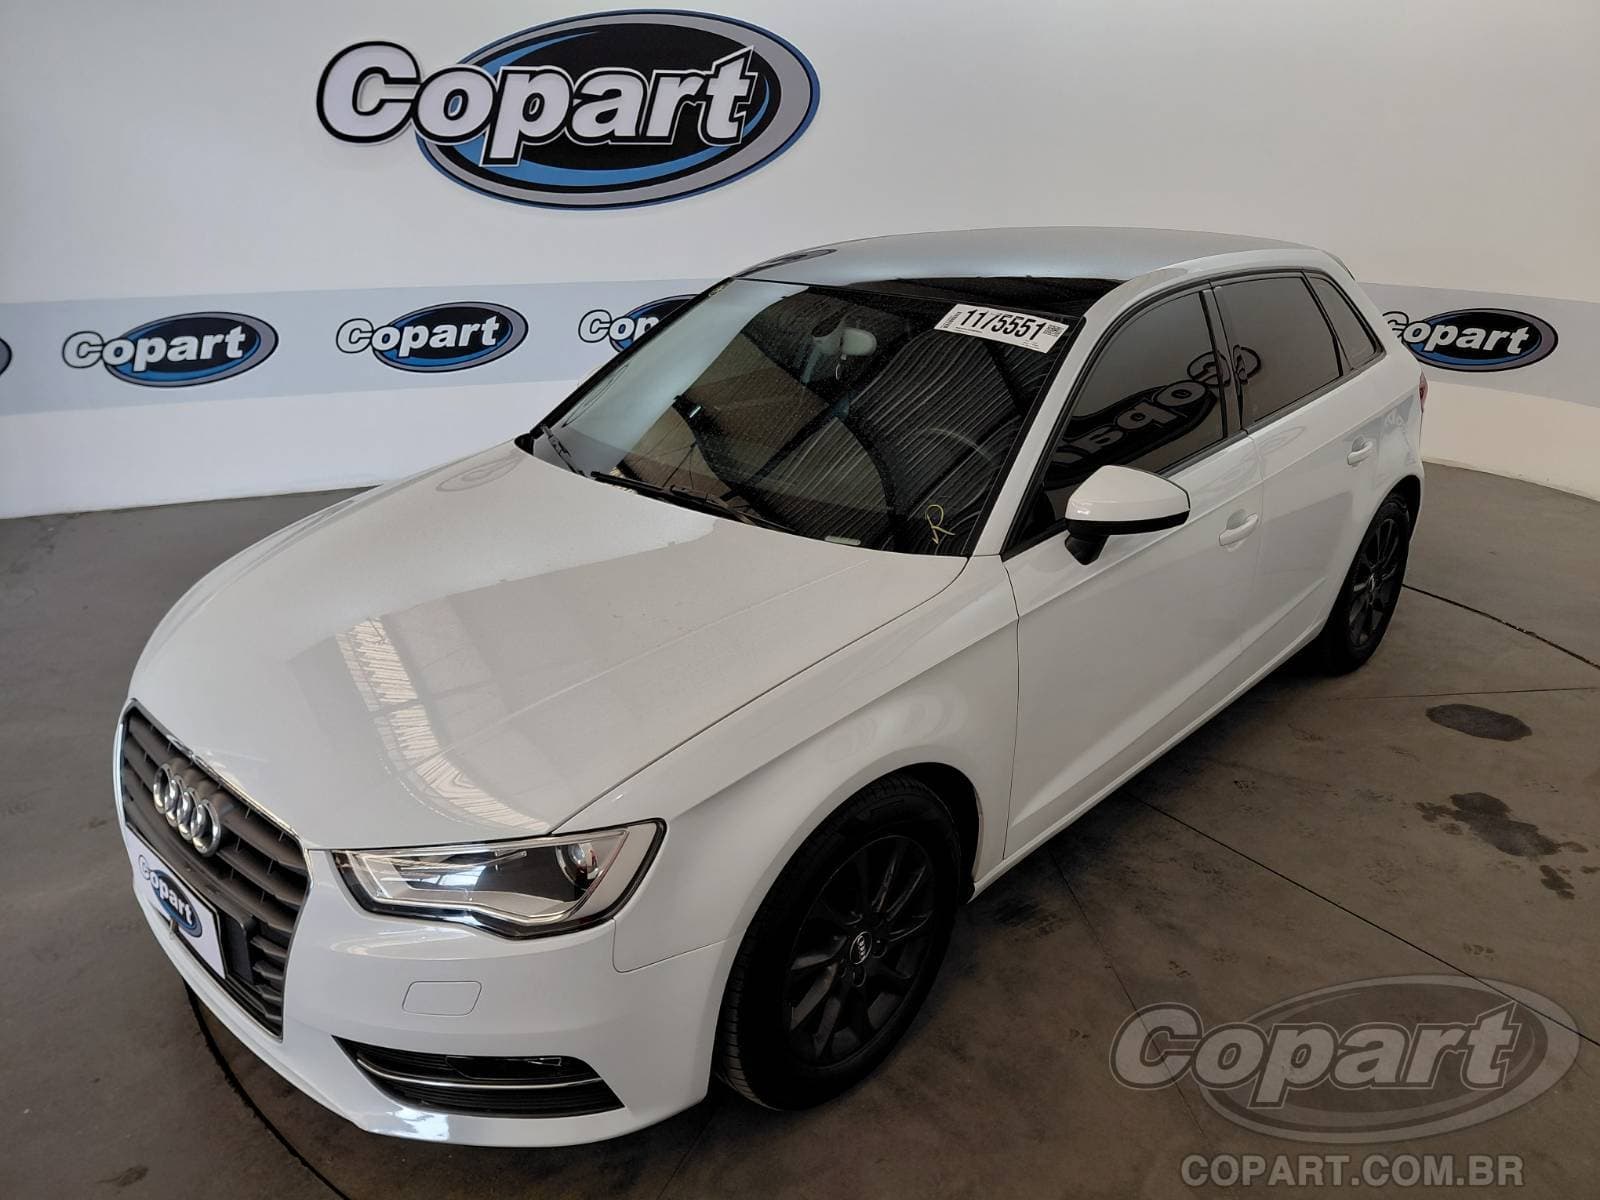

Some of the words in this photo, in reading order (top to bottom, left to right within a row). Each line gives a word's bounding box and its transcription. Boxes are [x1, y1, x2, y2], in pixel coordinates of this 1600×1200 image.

[316, 40, 758, 167] Copart
[62, 325, 246, 372] Copart
[336, 316, 500, 358] Copart
[138, 854, 195, 925] Copart
